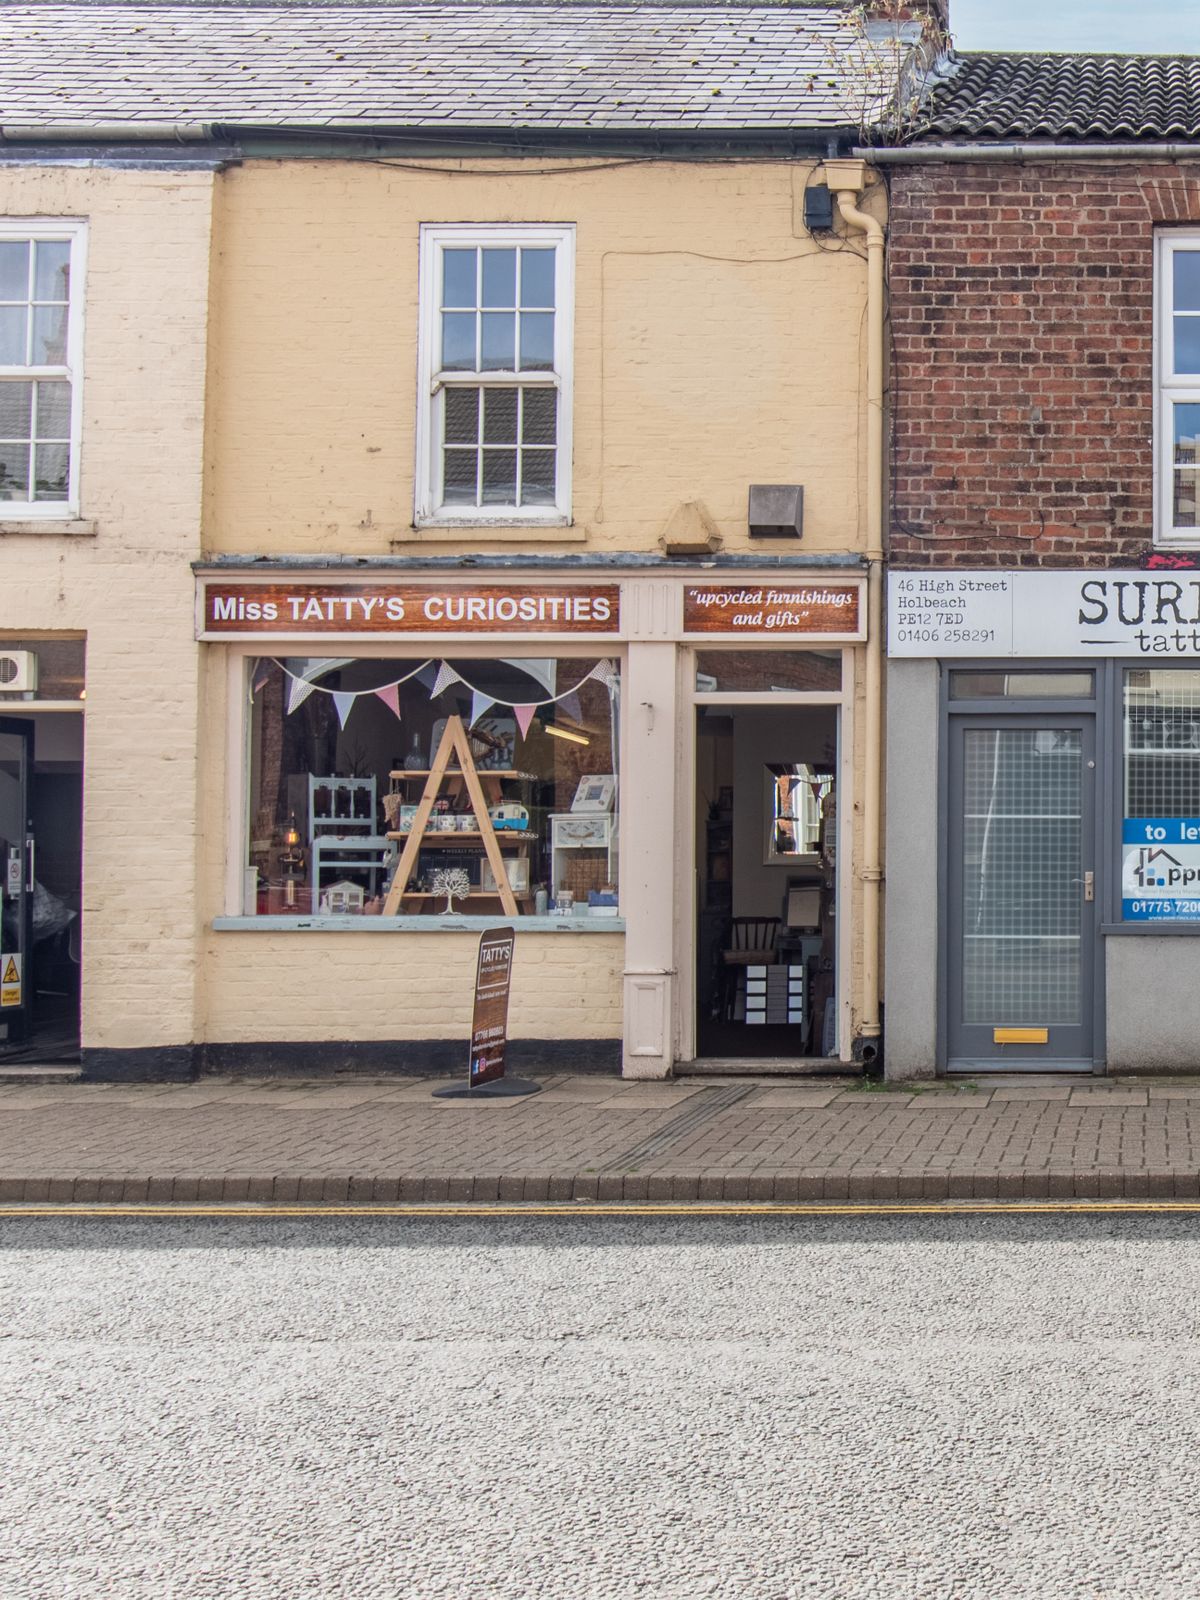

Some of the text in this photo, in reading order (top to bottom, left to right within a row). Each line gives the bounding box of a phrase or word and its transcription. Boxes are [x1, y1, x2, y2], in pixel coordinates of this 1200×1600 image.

[898, 579, 1008, 594] 46 High Street
[765, 590, 853, 608] furnishings
[898, 597, 966, 608] Holbeach
[213, 597, 611, 621] Miss TATTY'S CURIOSITIES
[733, 611, 762, 626] and
[898, 613, 964, 626] PE12 7ED
[898, 630, 995, 642] 01406 258291
[1145, 825, 1166, 840] to
[1132, 901, 1171, 913] 01775
[482, 945, 510, 963] TATTY'S
